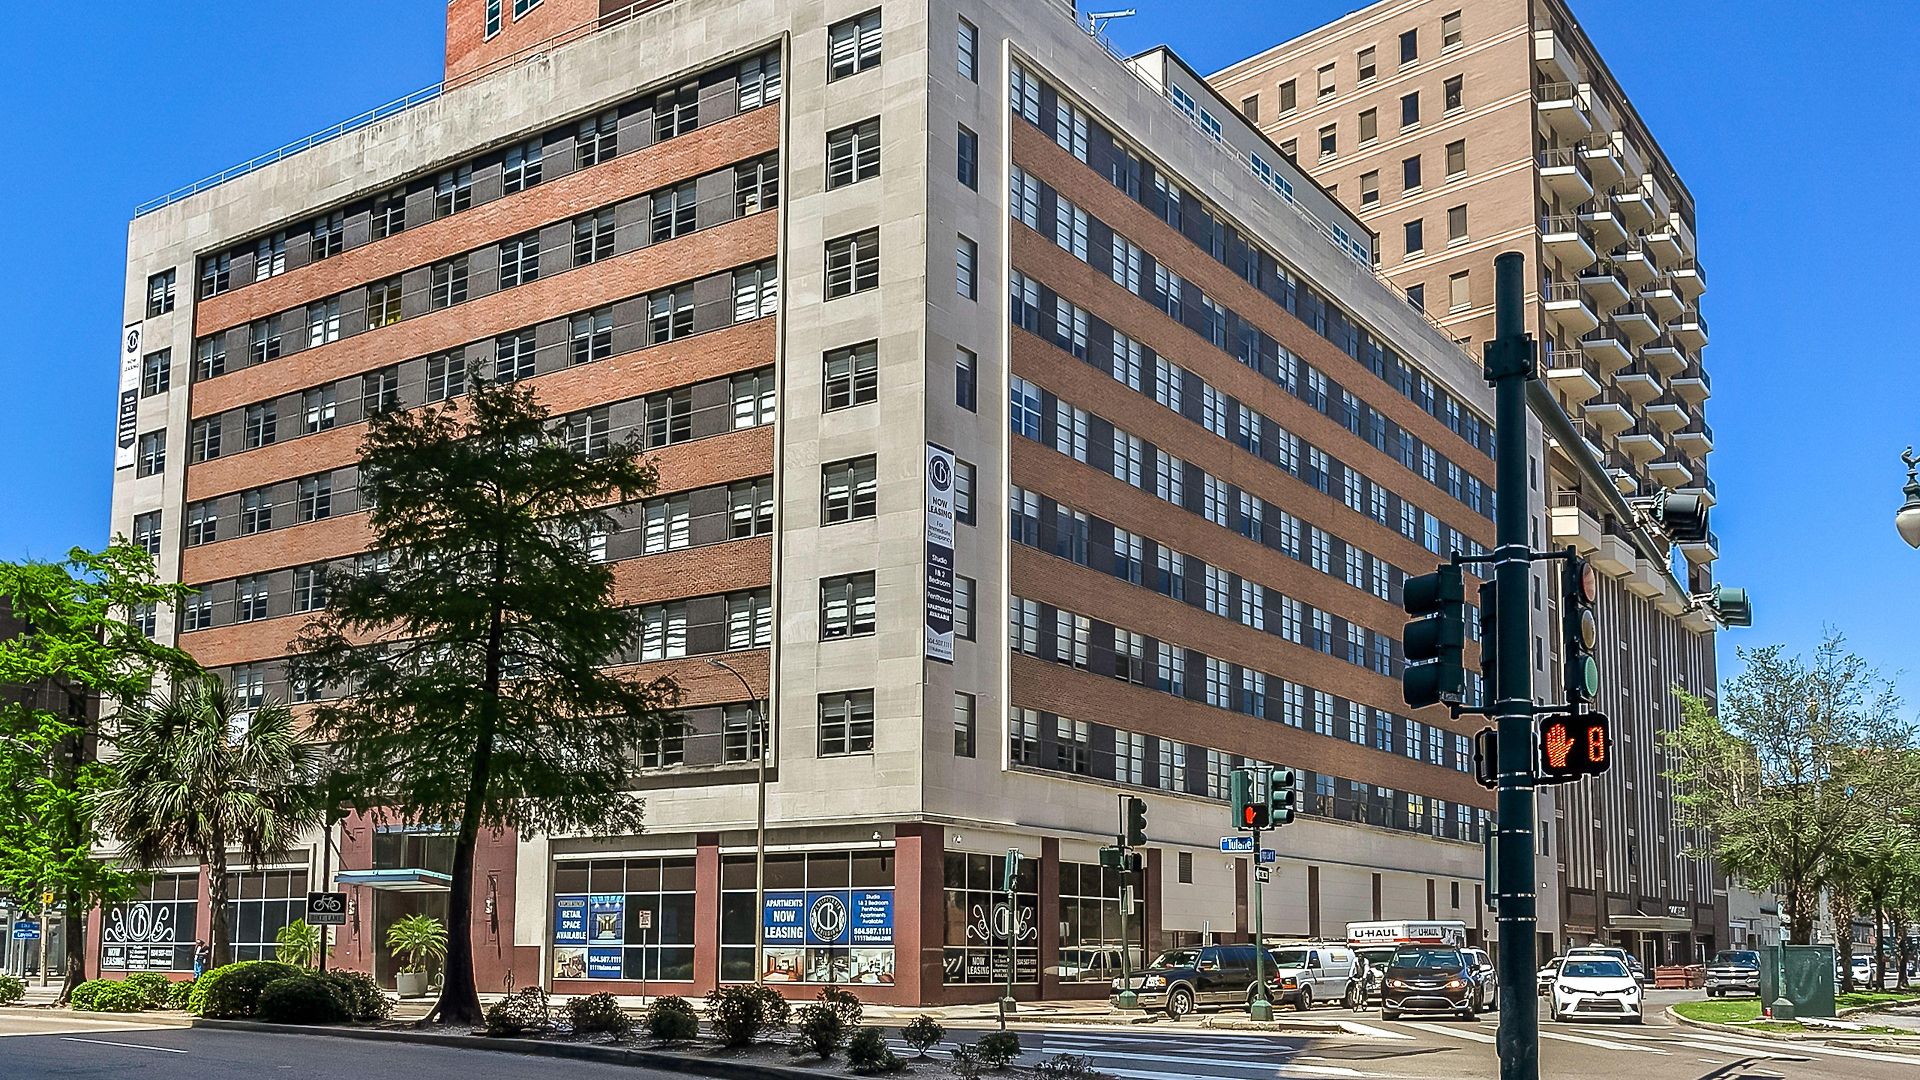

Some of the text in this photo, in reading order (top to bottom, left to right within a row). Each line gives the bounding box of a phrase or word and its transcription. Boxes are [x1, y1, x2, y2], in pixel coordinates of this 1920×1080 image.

[932, 496, 948, 508] NOW
[928, 504, 953, 520] LEASING
[931, 554, 948, 565] Studio
[928, 575, 951, 588] Bedroom
[927, 590, 953, 605] Penthouse
[1588, 727, 1604, 762] 8
[1228, 838, 1252, 850] Tulane
[766, 899, 804, 908] APARTMENTS
[562, 910, 581, 919] RETAIL
[773, 910, 796, 923] NOW
[562, 920, 581, 929] SPACE
[556, 931, 587, 940] AVAILABLE
[764, 926, 804, 939] LEASING
[1354, 928, 1398, 938] U-HAUL
[1418, 928, 1439, 937] U-HAUL
[107, 947, 121, 957] NOW
[102, 956, 125, 966] LEASING
[972, 957, 985, 966] NOW
[967, 966, 989, 975] LEASING
